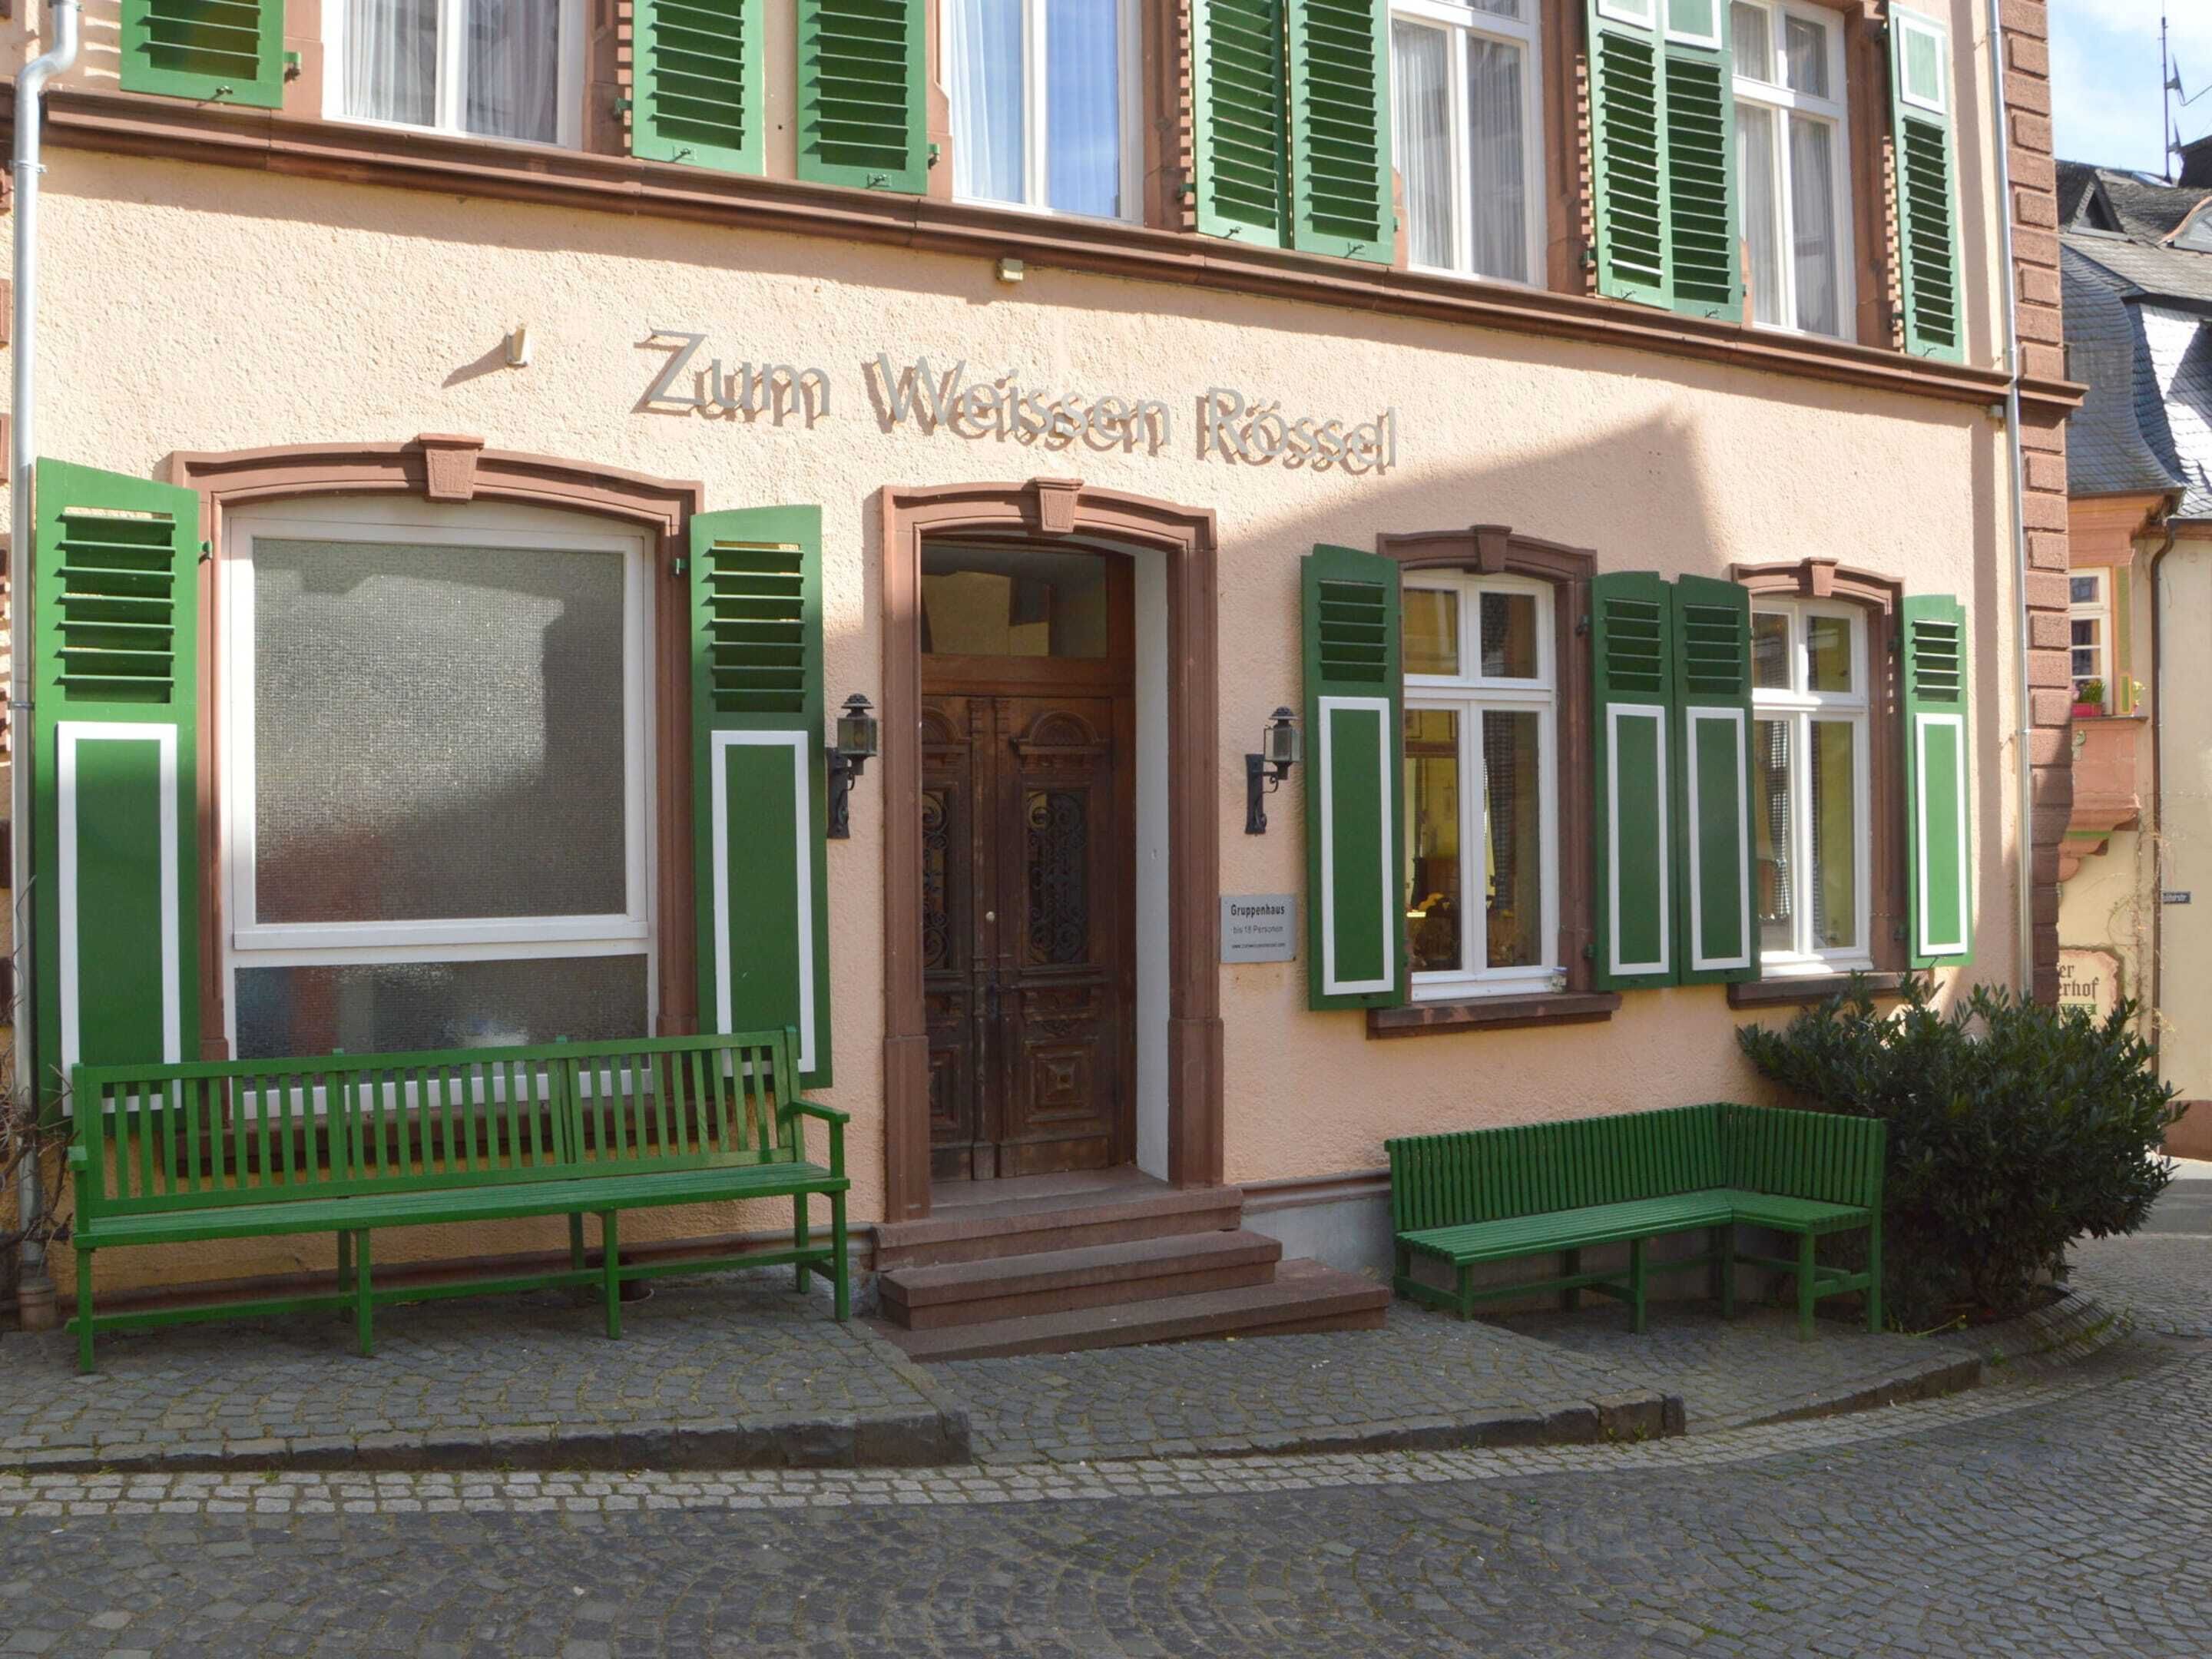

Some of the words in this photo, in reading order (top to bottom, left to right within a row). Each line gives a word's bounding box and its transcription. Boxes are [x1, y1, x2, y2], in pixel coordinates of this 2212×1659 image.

[645, 329, 830, 417] Zum
[877, 353, 1172, 447] Weissen
[1208, 386, 1396, 467] Rössel
[1230, 903, 1285, 918] Gruppenhaus
